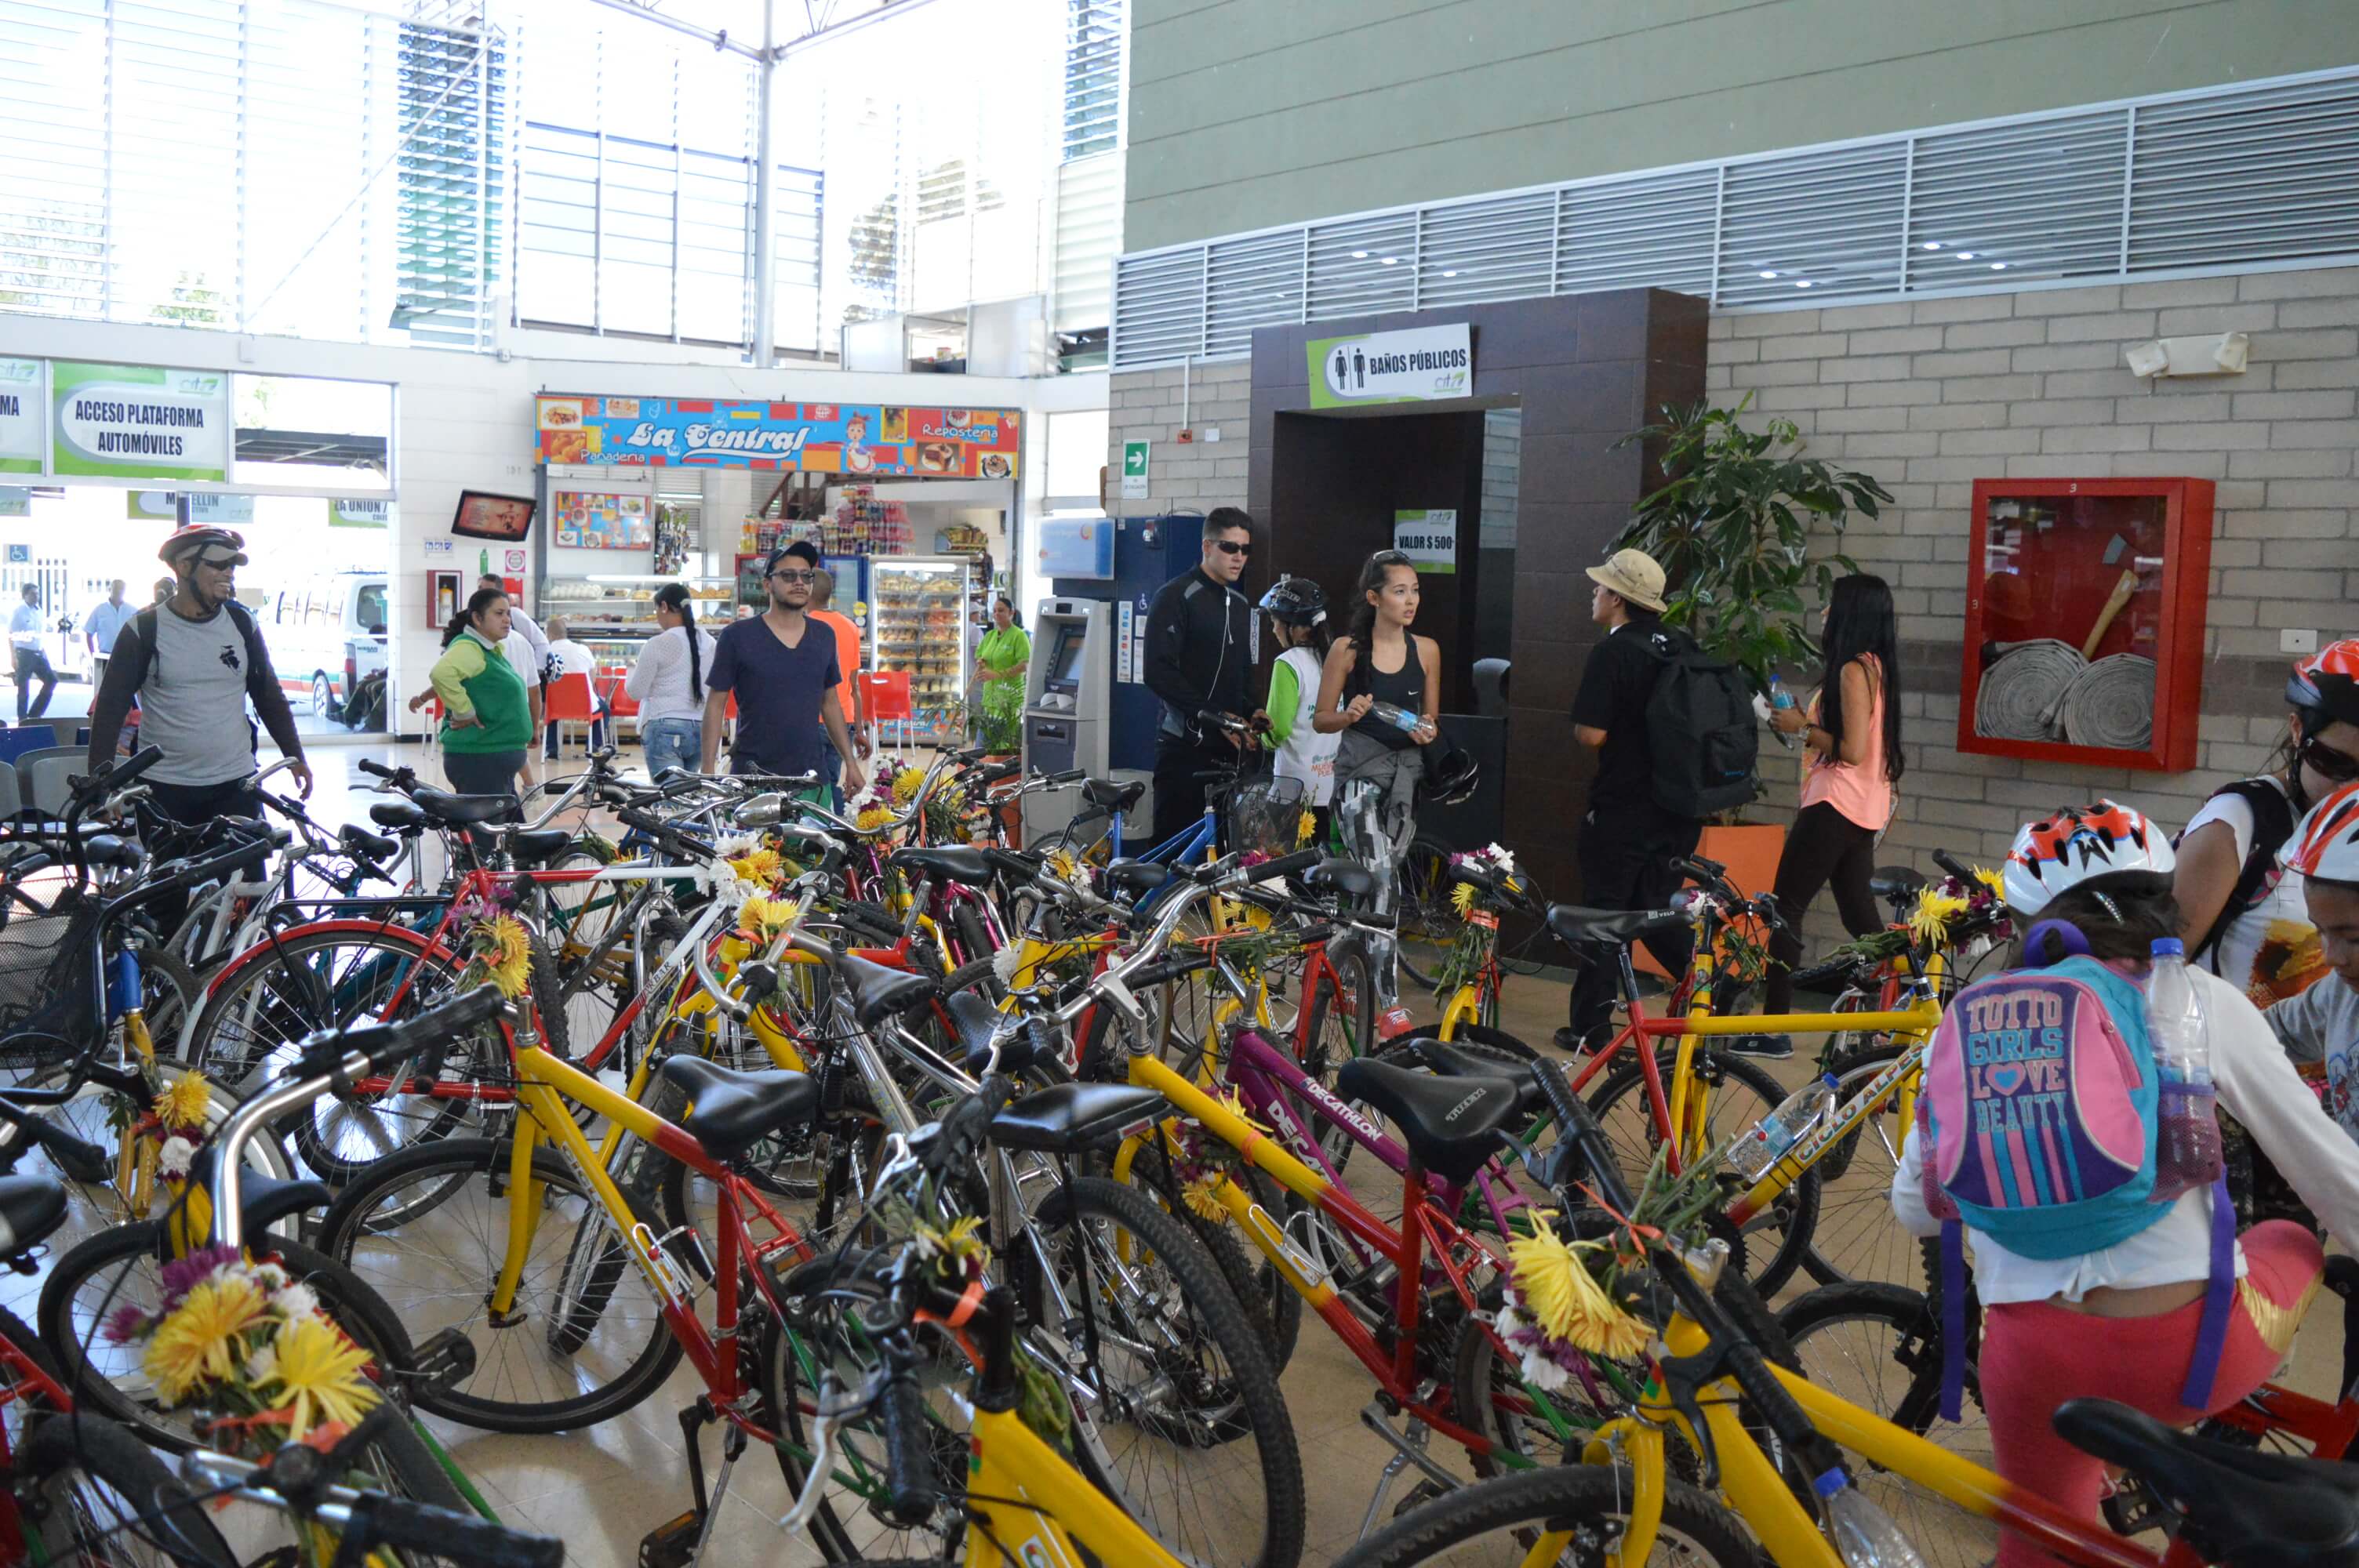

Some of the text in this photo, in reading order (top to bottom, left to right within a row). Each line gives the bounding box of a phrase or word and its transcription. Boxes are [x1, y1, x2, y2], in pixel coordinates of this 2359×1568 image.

[1370, 349, 1467, 375] BAÑOS PÚBLICOS
[75, 400, 204, 428] ACCESO PLATAFORMA
[98, 430, 183, 456] AUTOMÓVILES
[626, 423, 811, 455] La Central
[165, 492, 220, 508] MELLIN
[2070, 484, 2077, 492] 3
[1398, 535, 1425, 549] VALOR
[1434, 535, 1452, 549] 500
[1966, 989, 2062, 1033] TOTTO
[1968, 1027, 2064, 1065] GIRLS
[1307, 1082, 1383, 1142] DECATHLON
[1799, 1040, 1925, 1161] CICLO ALPES
[1973, 1091, 2067, 1134] BEAUTY
